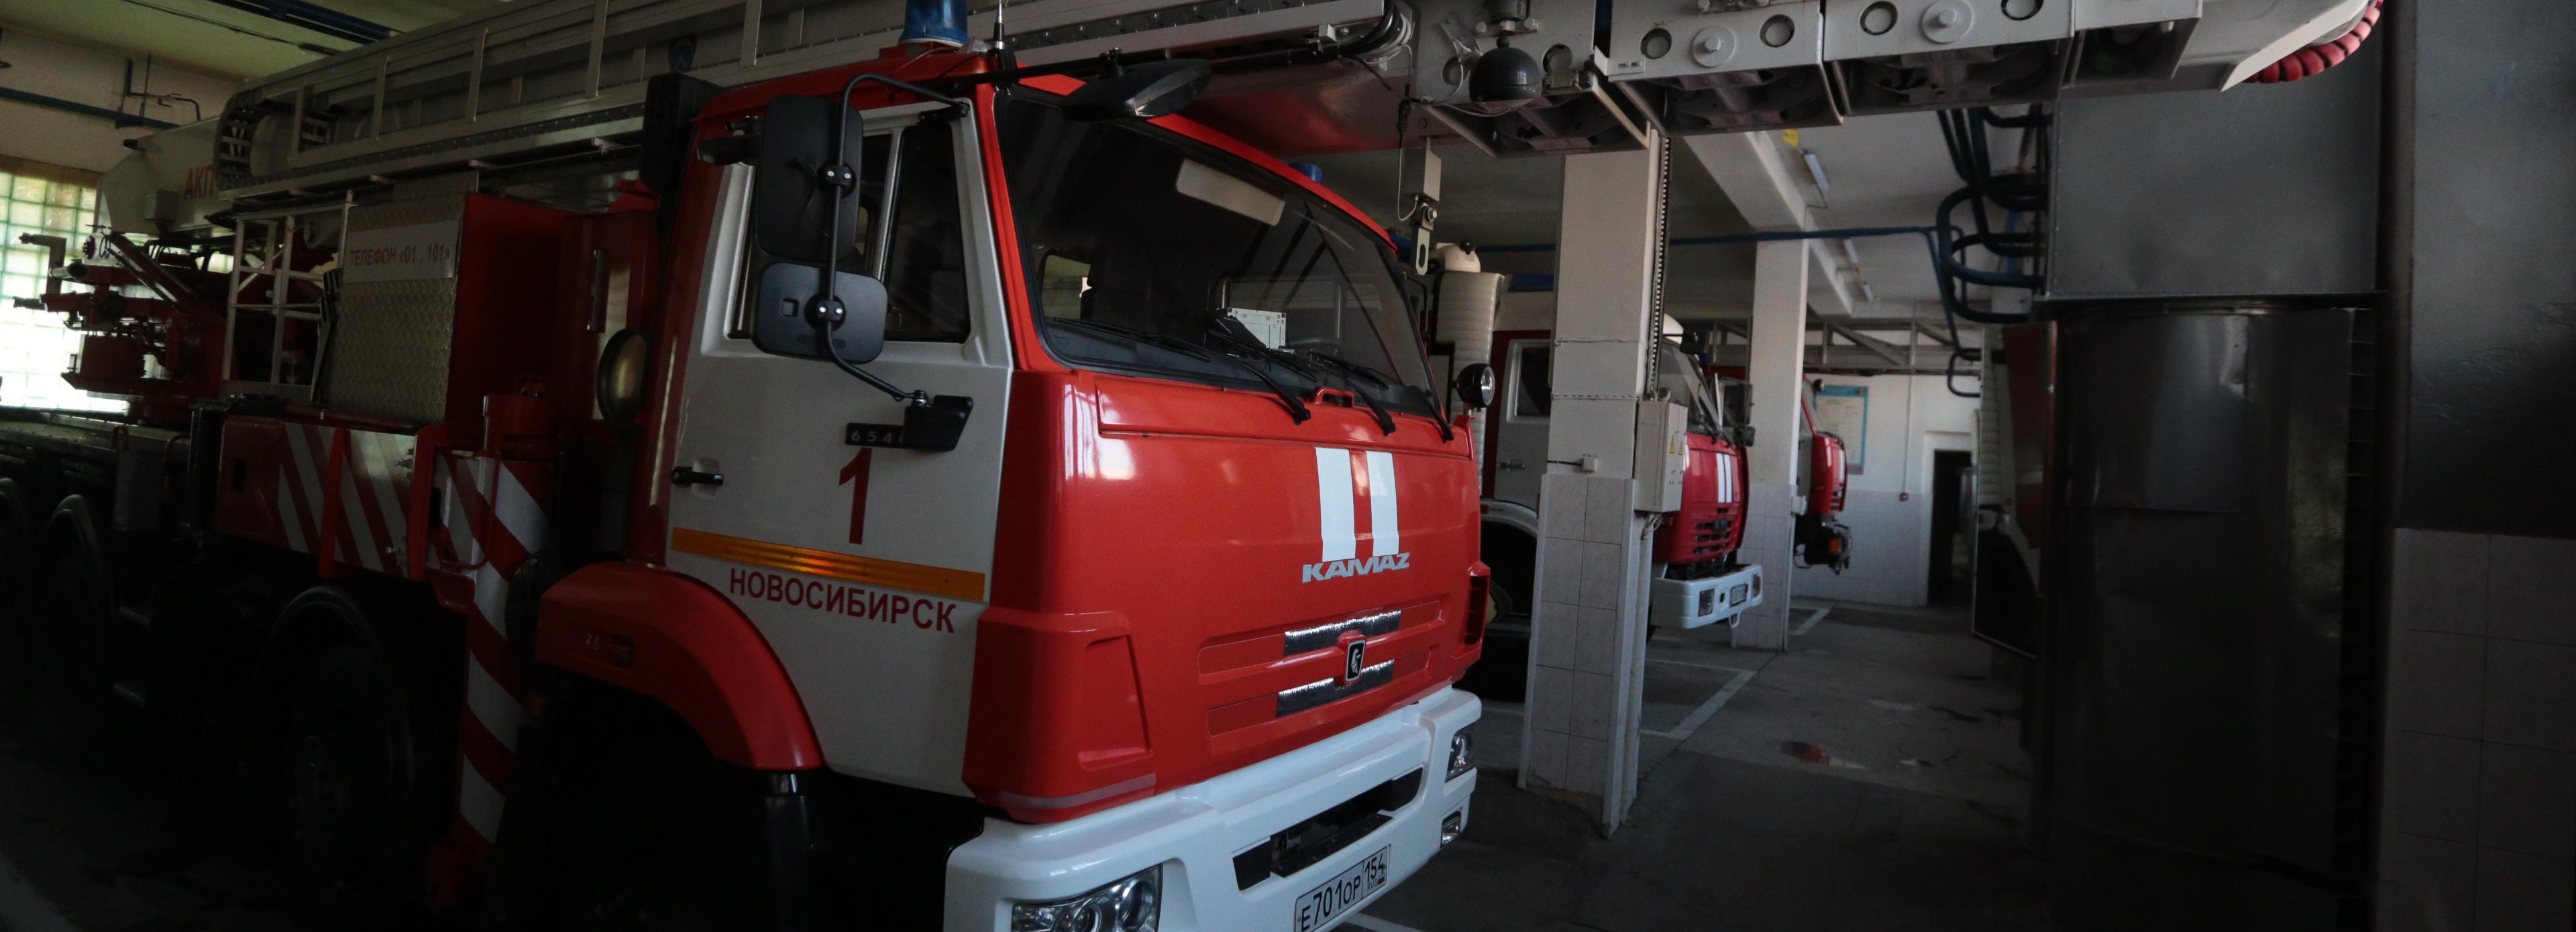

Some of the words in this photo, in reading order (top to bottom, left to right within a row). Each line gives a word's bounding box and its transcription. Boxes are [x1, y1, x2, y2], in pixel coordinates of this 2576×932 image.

[350, 247, 397, 266] ТЕЛЕФОН
[839, 447, 872, 544] 1
[1302, 552, 1410, 583] KAMAZ
[730, 568, 956, 634] НОВОСИБИРСК
[1364, 853, 1386, 882] 154
[1368, 879, 1378, 890] RUS
